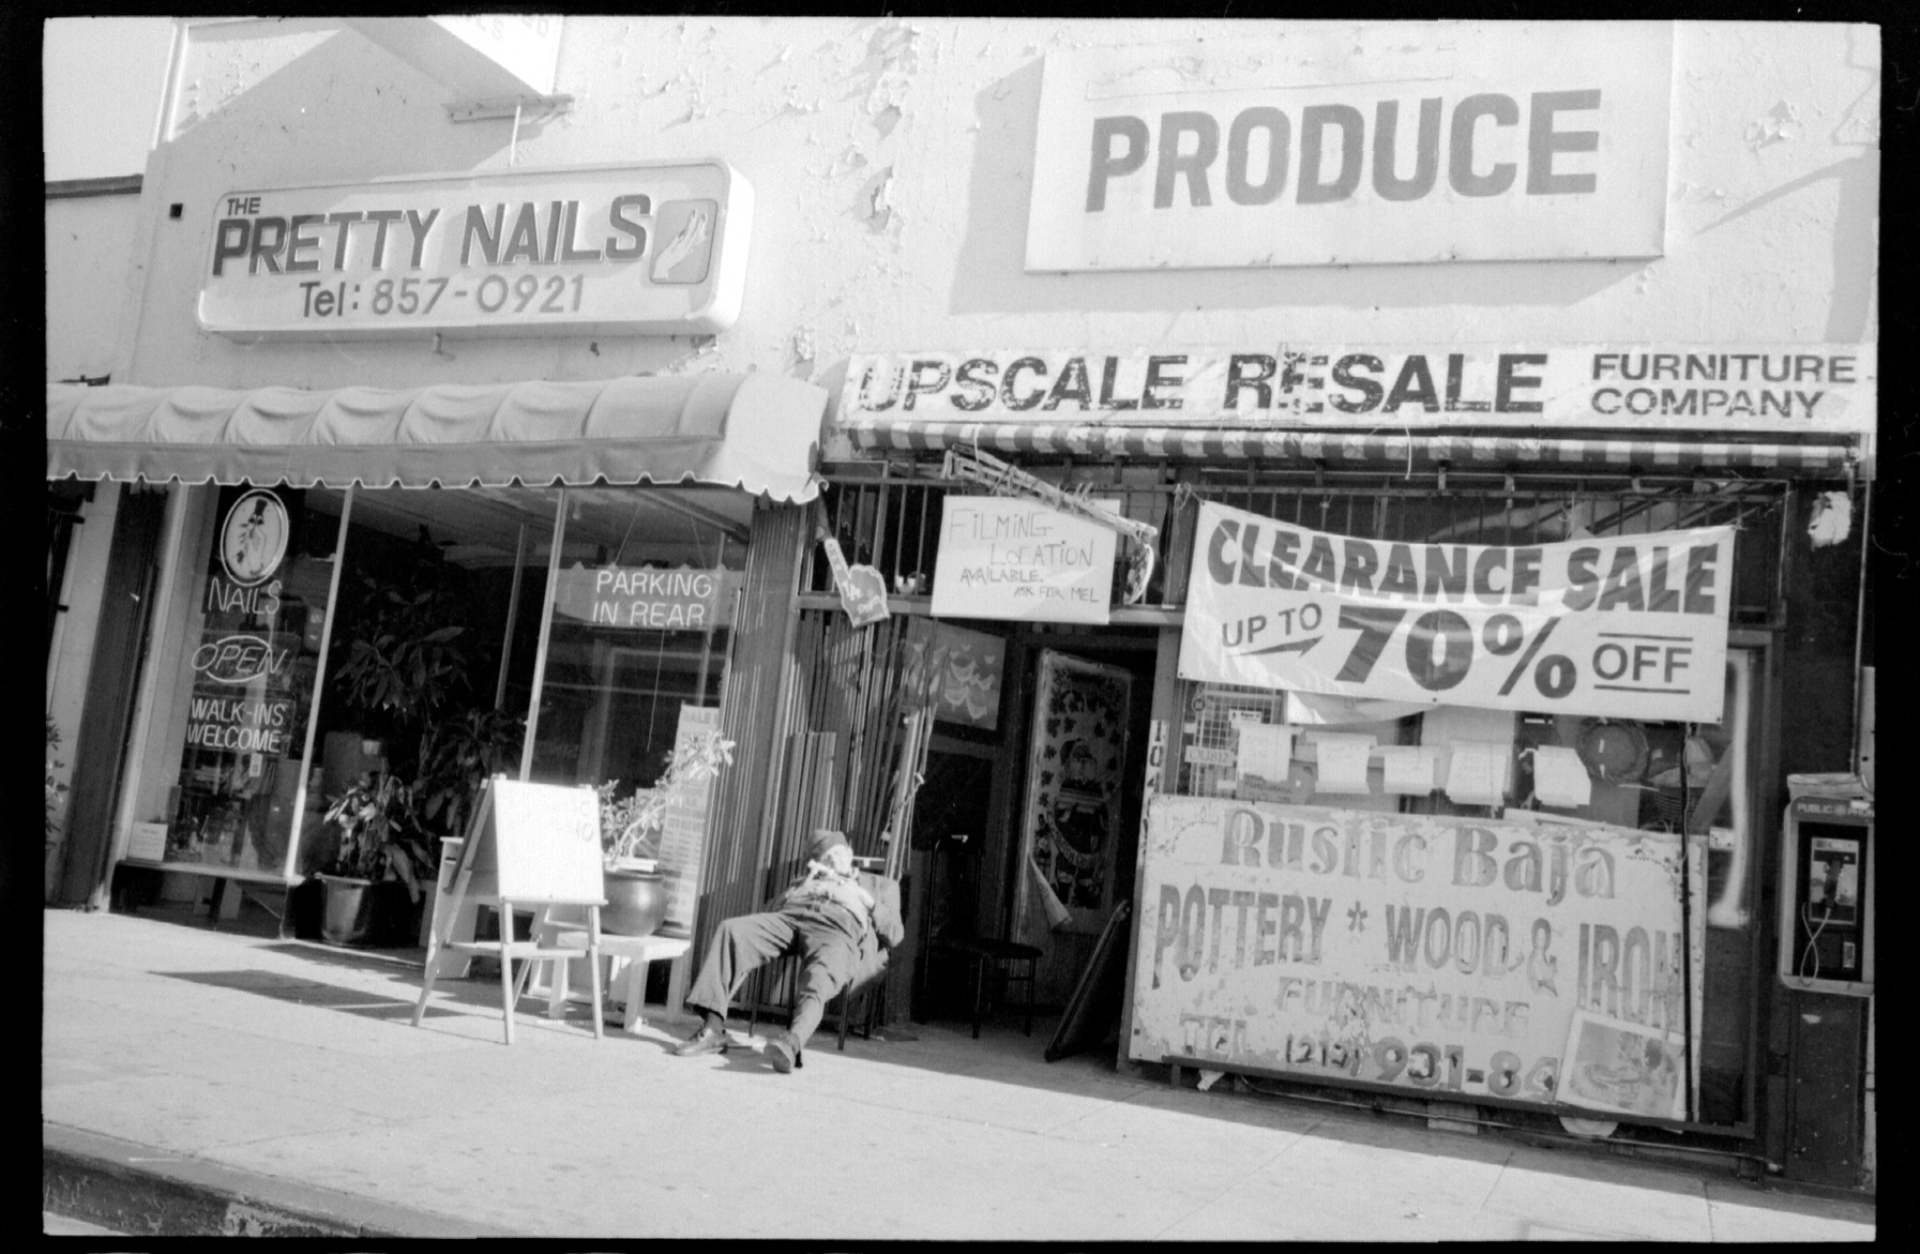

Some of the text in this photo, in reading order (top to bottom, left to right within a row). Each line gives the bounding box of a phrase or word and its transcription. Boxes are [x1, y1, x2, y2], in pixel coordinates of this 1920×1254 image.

[1085, 88, 1602, 213] PRODUCE
[227, 197, 261, 216] THE
[212, 194, 652, 276] PRETTY NAILS
[299, 273, 584, 318] Tel: 857-0921
[858, 352, 1548, 414] UPSCALE RESALE
[1592, 353, 1857, 383] FURNITURE
[1590, 387, 1825, 419] COMPANY
[596, 570, 712, 598] PARKING
[1207, 518, 1719, 615] CLEARANCE SALE
[208, 577, 283, 615] NAILS
[1038, 585, 1064, 599] FOR
[1070, 586, 1099, 603] MEL
[592, 601, 705, 627] IN REAR
[1221, 602, 1323, 648] UP TO
[191, 643, 288, 675] OPEN
[1333, 604, 1577, 699] 70%
[1592, 643, 1693, 683] OFF
[190, 698, 288, 726] WALK-INS
[187, 724, 282, 753] WELCOME
[1797, 802, 1832, 815] PUBLIC
[1219, 808, 1616, 907] Rustic Baja
[1152, 883, 1684, 1036] POTTERY WOOD & IRON
